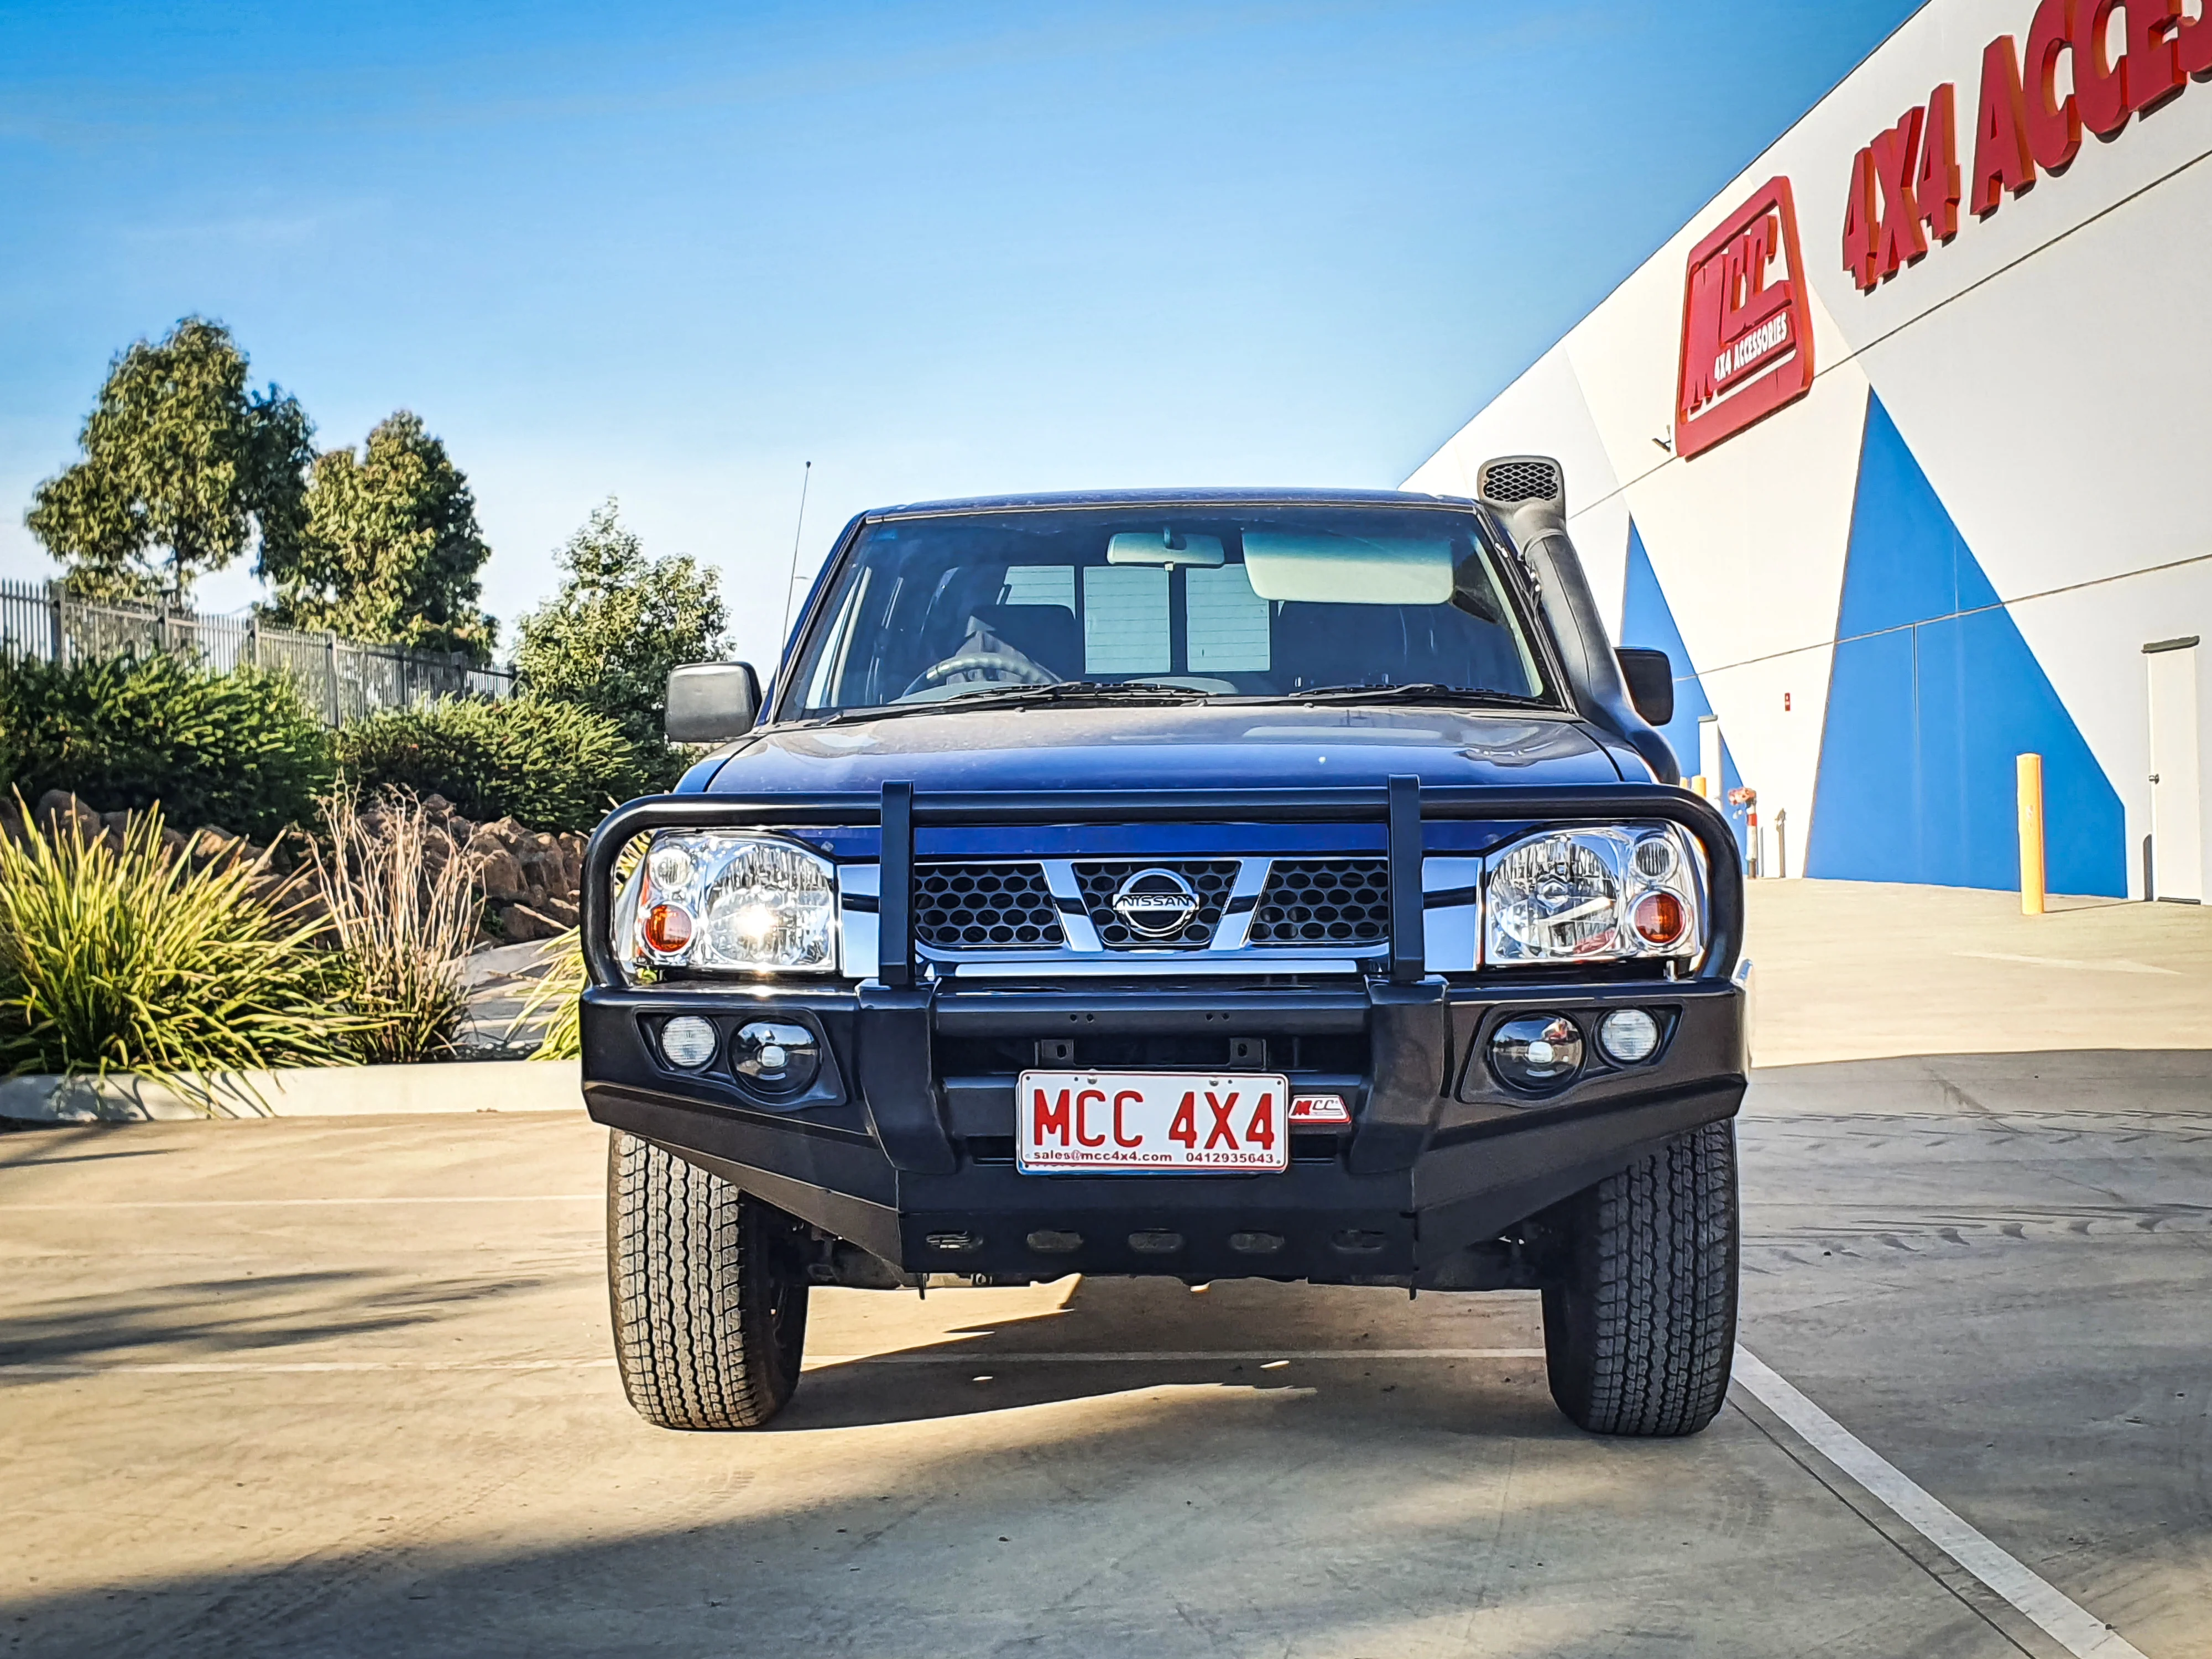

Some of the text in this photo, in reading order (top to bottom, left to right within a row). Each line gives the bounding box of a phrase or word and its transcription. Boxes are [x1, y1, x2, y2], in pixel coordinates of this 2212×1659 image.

[1843, 0, 2212, 290] 4X4 ACCE
[1714, 311, 1787, 383] 4X4 ACCESSORIES
[1123, 895, 1190, 907] NISSAN
[1033, 1089, 1275, 1150] MCC 4X4
[1034, 1150, 1172, 1162] sales@mcc4x4.com
